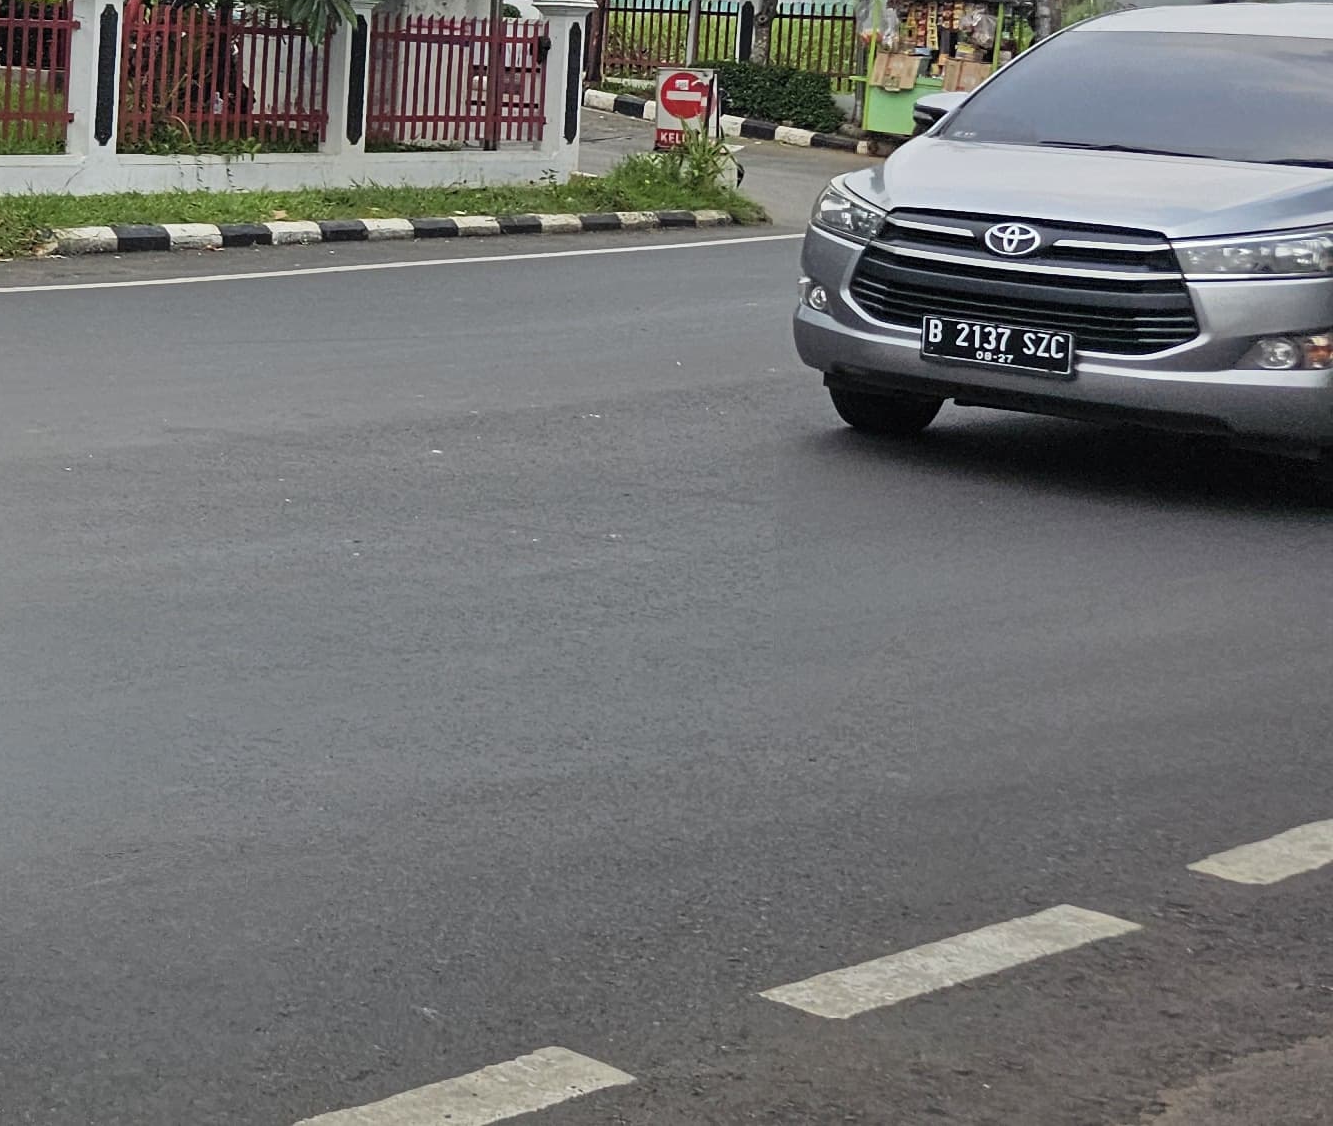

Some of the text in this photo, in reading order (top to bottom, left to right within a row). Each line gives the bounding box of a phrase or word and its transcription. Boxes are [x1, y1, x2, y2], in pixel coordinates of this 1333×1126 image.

[928, 319, 1066, 360] B 2137 SZC
